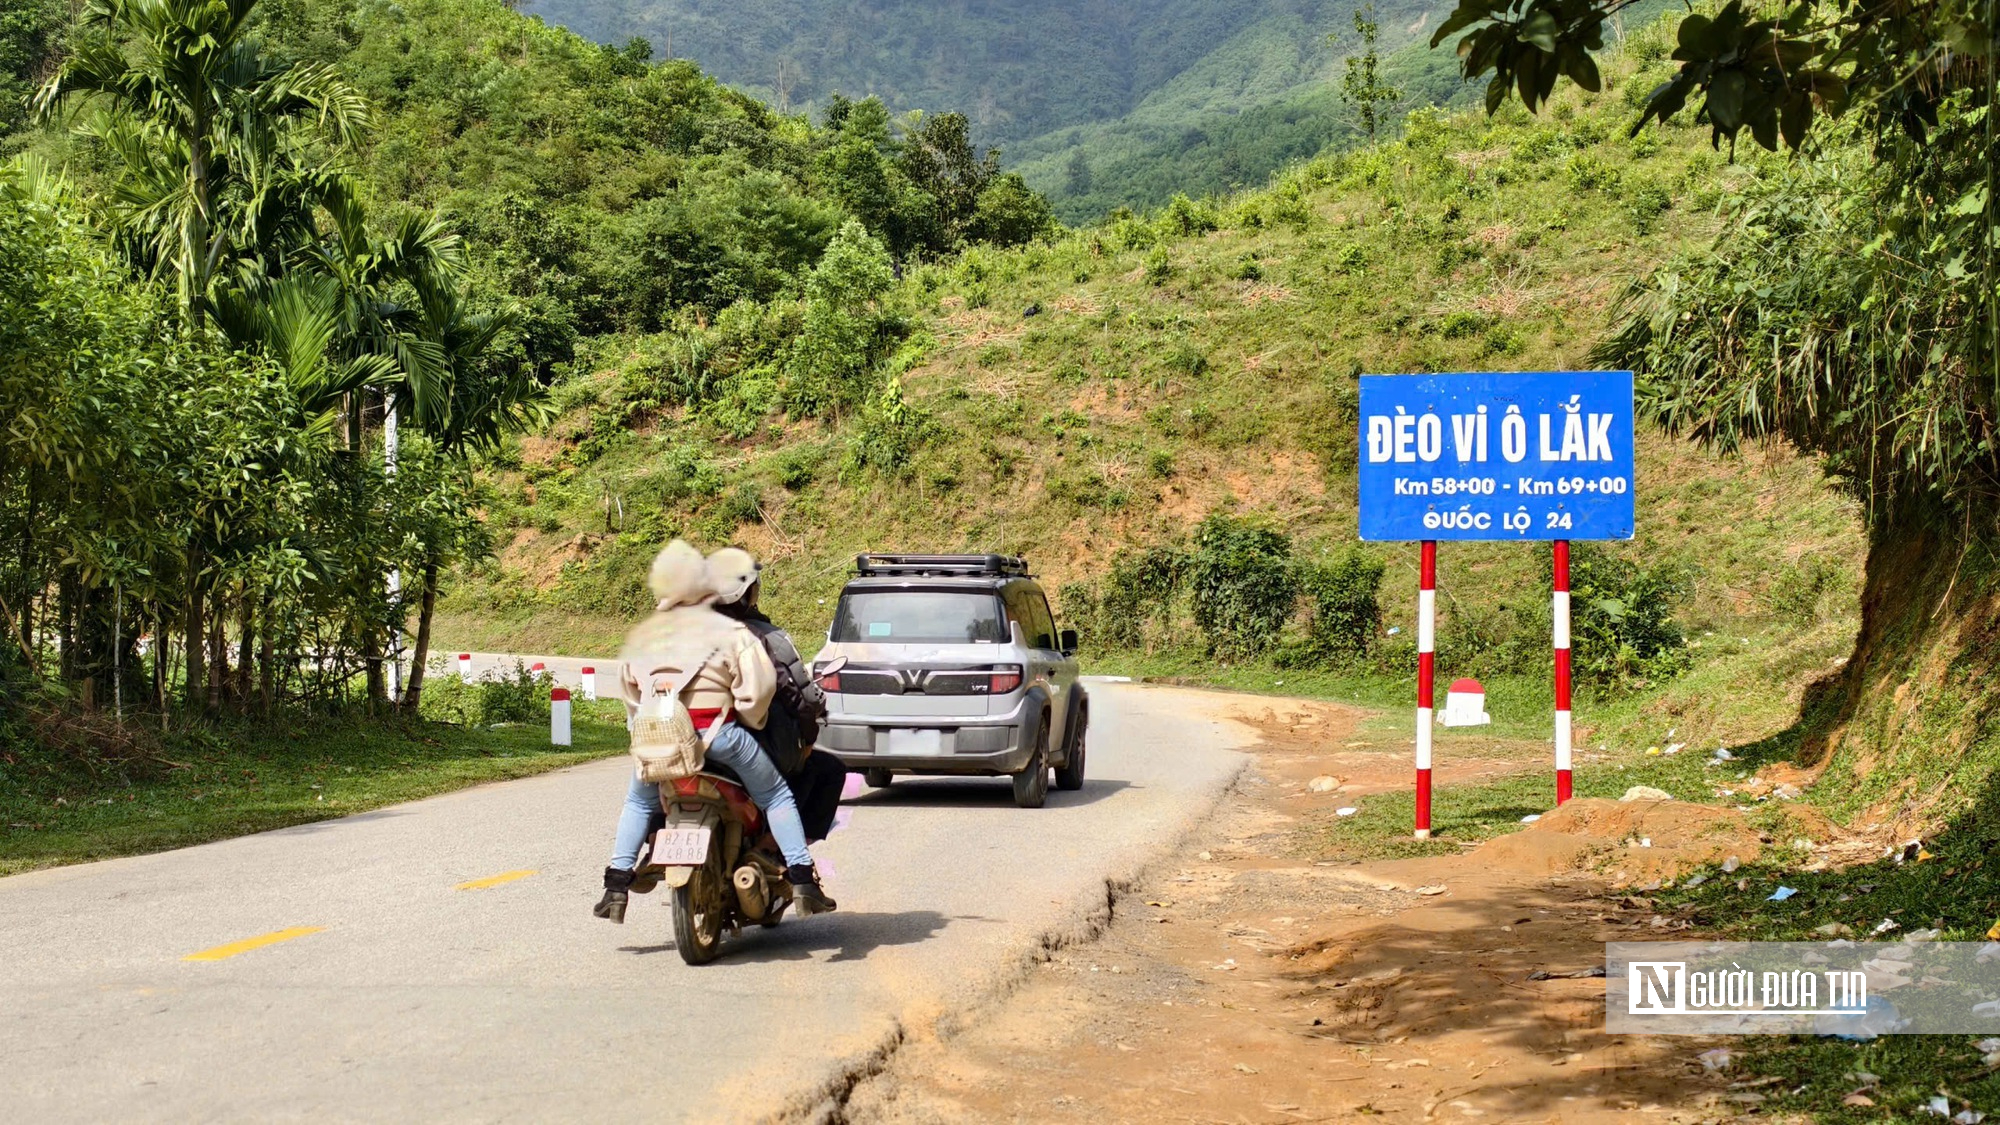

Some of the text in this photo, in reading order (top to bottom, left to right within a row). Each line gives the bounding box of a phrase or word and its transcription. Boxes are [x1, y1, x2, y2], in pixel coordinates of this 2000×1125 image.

[1366, 405, 1442, 463] ĐÈO
[1501, 404, 1527, 463] Ô
[1539, 394, 1614, 462] LẮK
[1422, 503, 1573, 535] QUỐC LỘ 24
